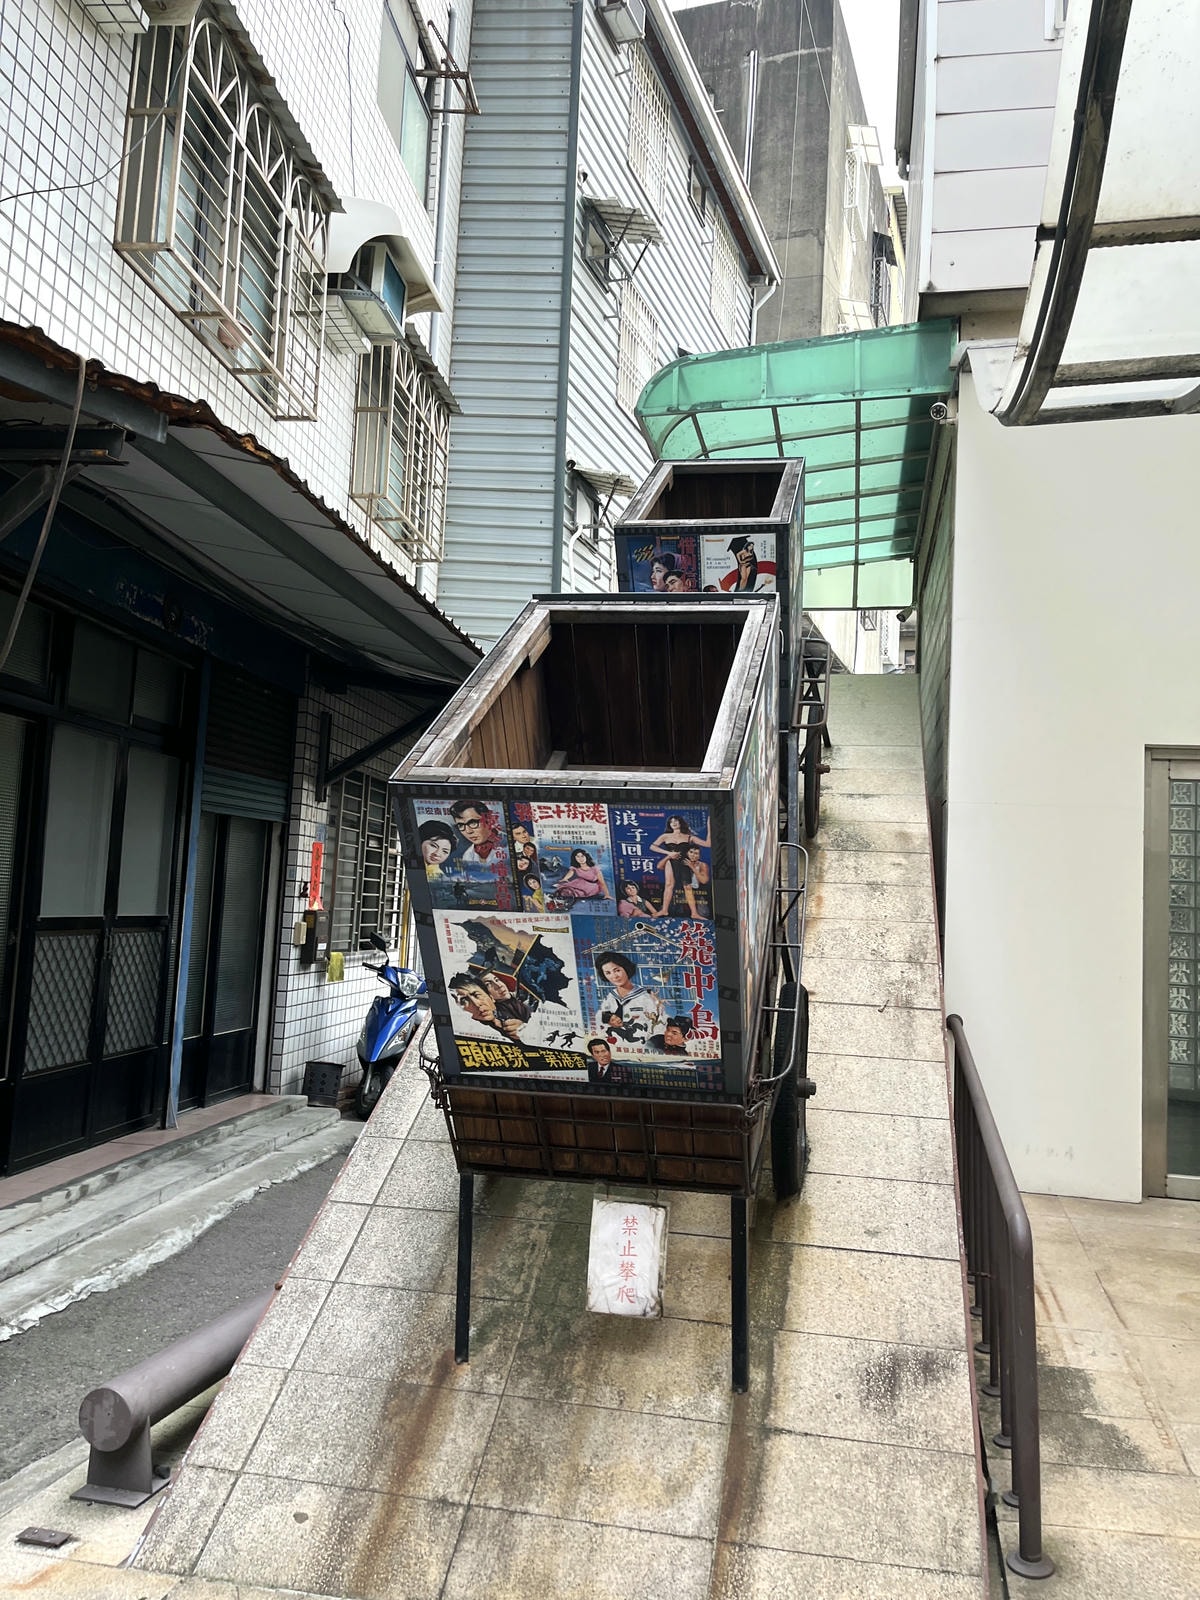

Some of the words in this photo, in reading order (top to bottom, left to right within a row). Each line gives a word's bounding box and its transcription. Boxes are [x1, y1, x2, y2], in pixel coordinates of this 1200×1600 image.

[615, 810, 654, 873] 浪子回頭
[679, 921, 719, 1041] 籠中鳥
[616, 1215, 639, 1304] 禁止攀爬
